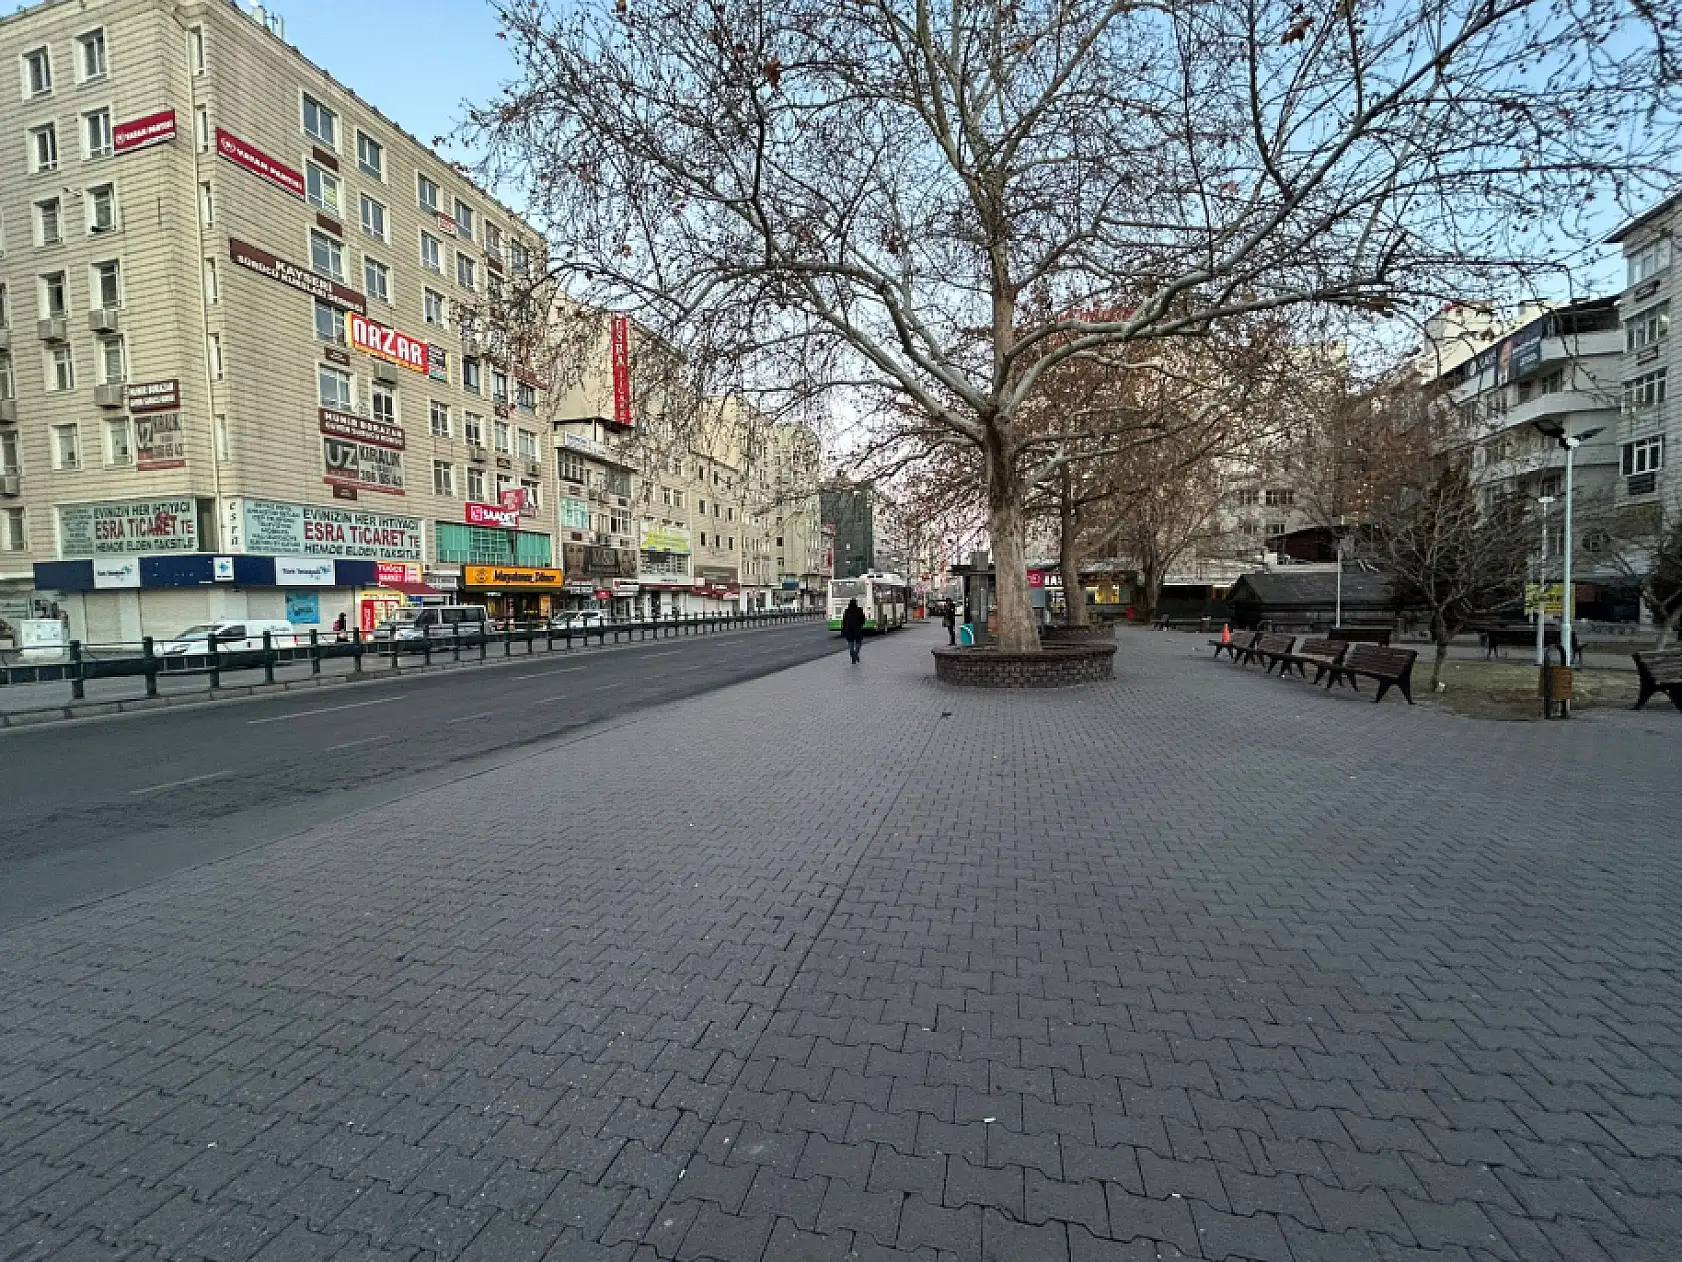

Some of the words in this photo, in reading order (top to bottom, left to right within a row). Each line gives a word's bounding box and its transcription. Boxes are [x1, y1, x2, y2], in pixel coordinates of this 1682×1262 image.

[353, 319, 422, 365] NAZAR
[95, 519, 126, 540] ESRA
[304, 520, 346, 542] ESRA
[349, 525, 406, 547] TİCARET
